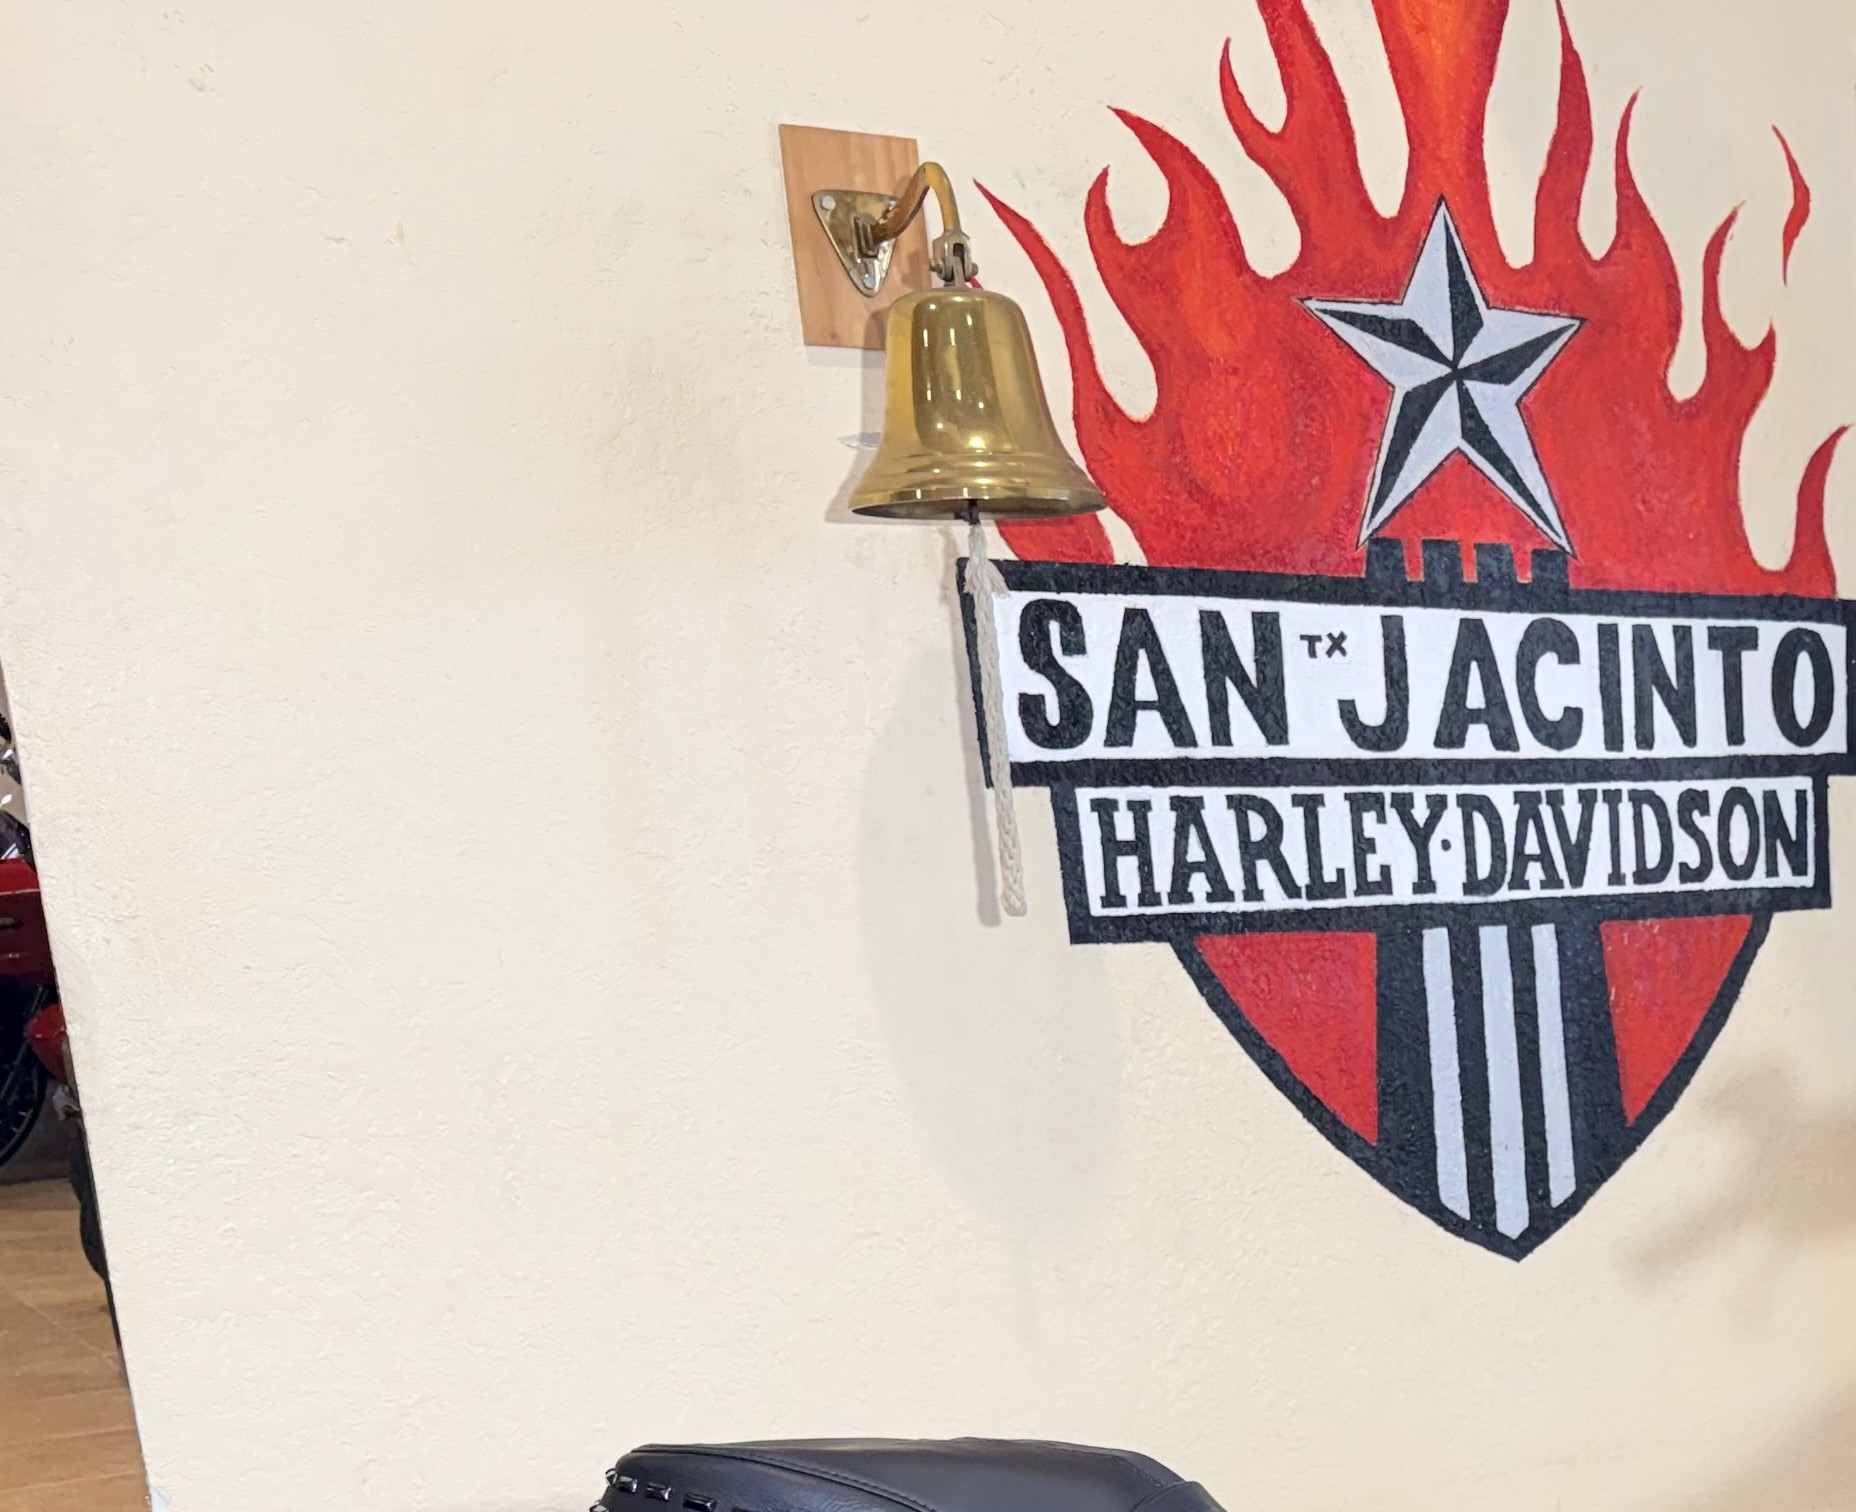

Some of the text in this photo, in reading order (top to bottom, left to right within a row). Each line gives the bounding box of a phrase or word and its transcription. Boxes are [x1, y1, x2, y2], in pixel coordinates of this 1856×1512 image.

[1017, 599, 1836, 753] SAN TX JACINTO
